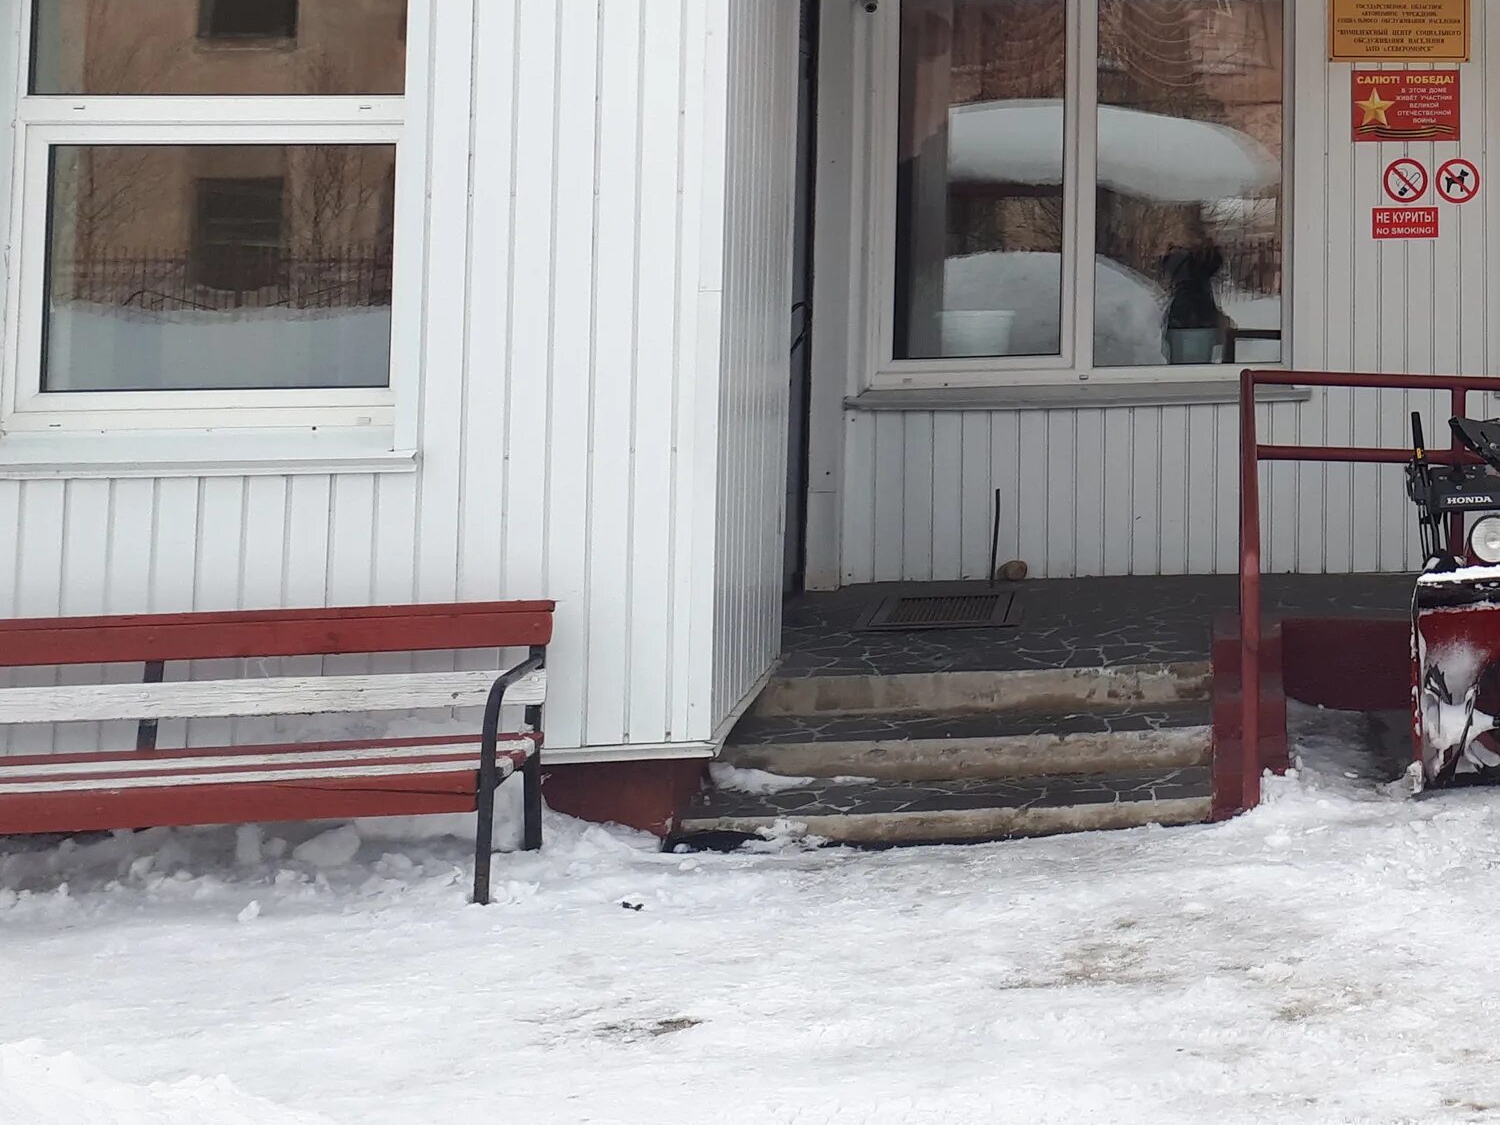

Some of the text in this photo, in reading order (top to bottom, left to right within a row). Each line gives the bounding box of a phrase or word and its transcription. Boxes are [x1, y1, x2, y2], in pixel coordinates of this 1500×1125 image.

[1356, 75, 1455, 85] САЛЮТ! ПОБЕДА!
[1412, 116, 1437, 124] ВОЙНЫ
[1376, 211, 1435, 223] НЕ КУРИТЬ!
[1376, 227, 1435, 235] NO SMOKING!
[1446, 496, 1493, 504] HONDA
